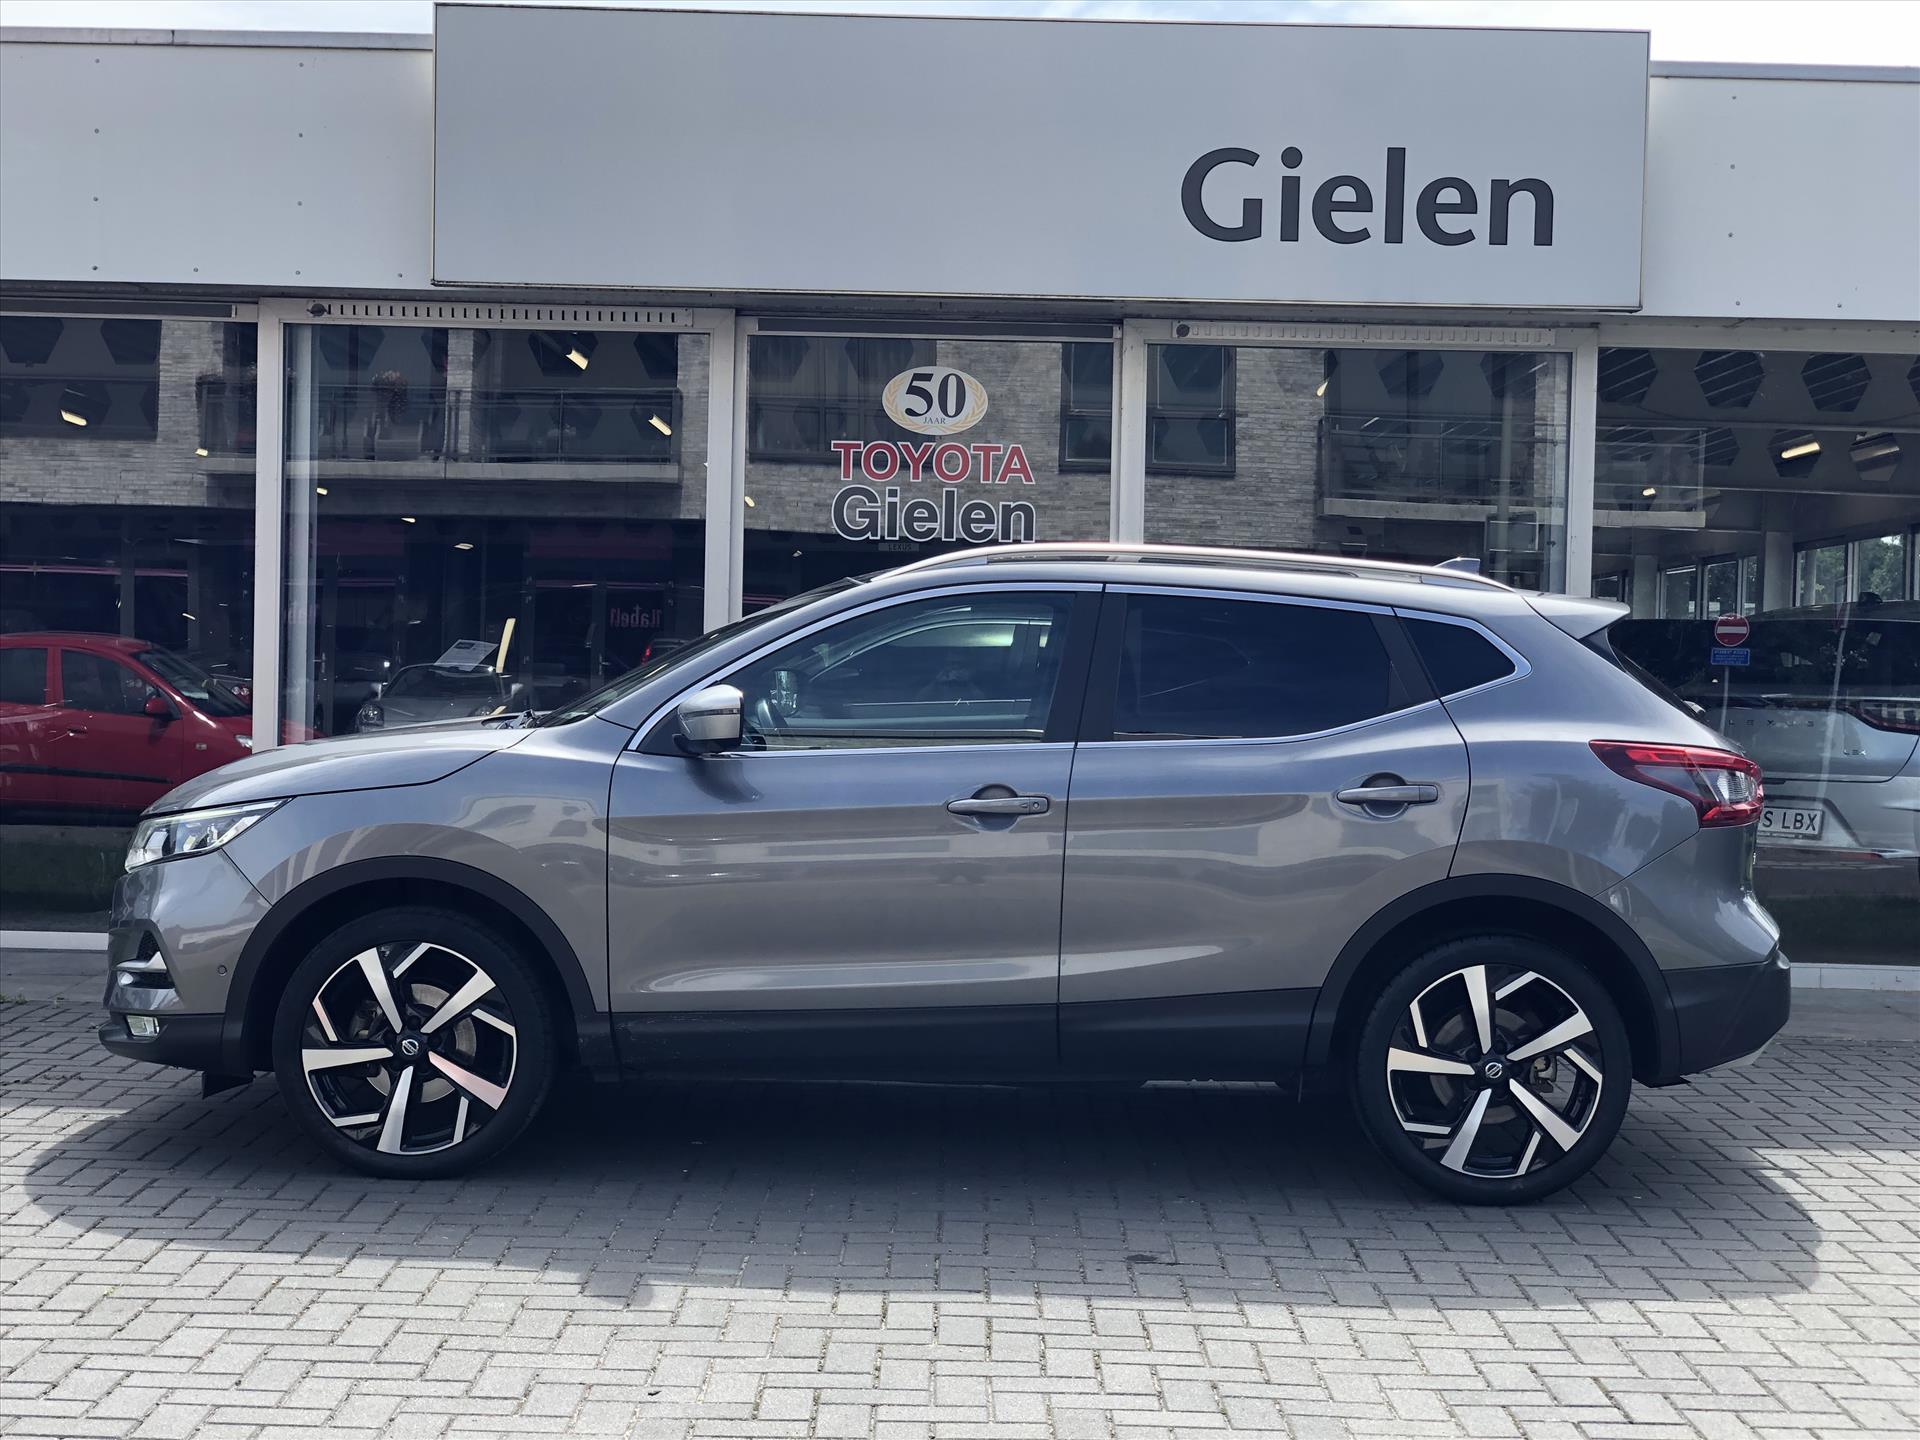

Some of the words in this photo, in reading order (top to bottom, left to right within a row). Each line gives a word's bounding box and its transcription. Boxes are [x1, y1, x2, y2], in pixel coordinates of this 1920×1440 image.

[1180, 146, 1554, 247] Gielen
[904, 373, 967, 418] 50
[923, 416, 946, 425] JAAR
[831, 440, 1036, 485] TOYOTA
[831, 484, 1036, 543] Gielen
[1781, 811, 1818, 832] LBX
